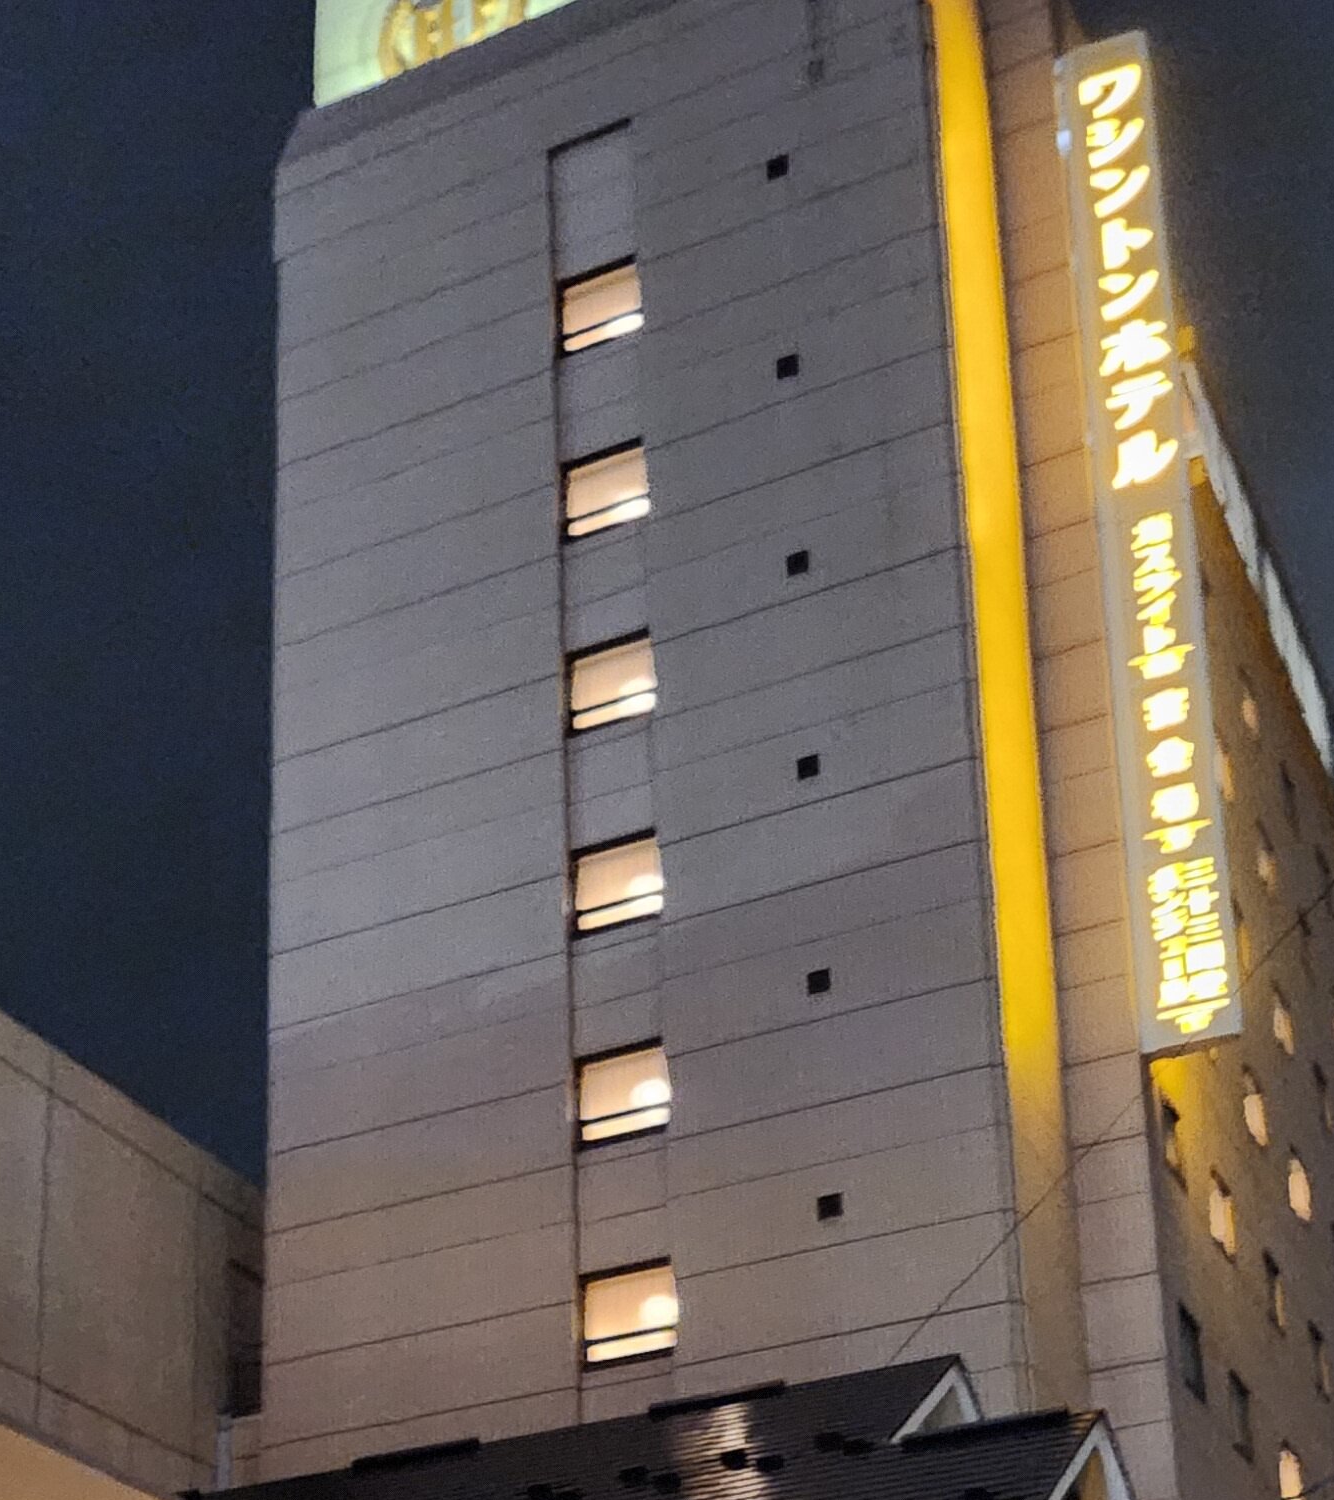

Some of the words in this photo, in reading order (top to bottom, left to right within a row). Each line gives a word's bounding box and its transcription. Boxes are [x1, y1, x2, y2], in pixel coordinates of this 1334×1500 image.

[1077, 63, 1179, 490] ワシントンホテル
